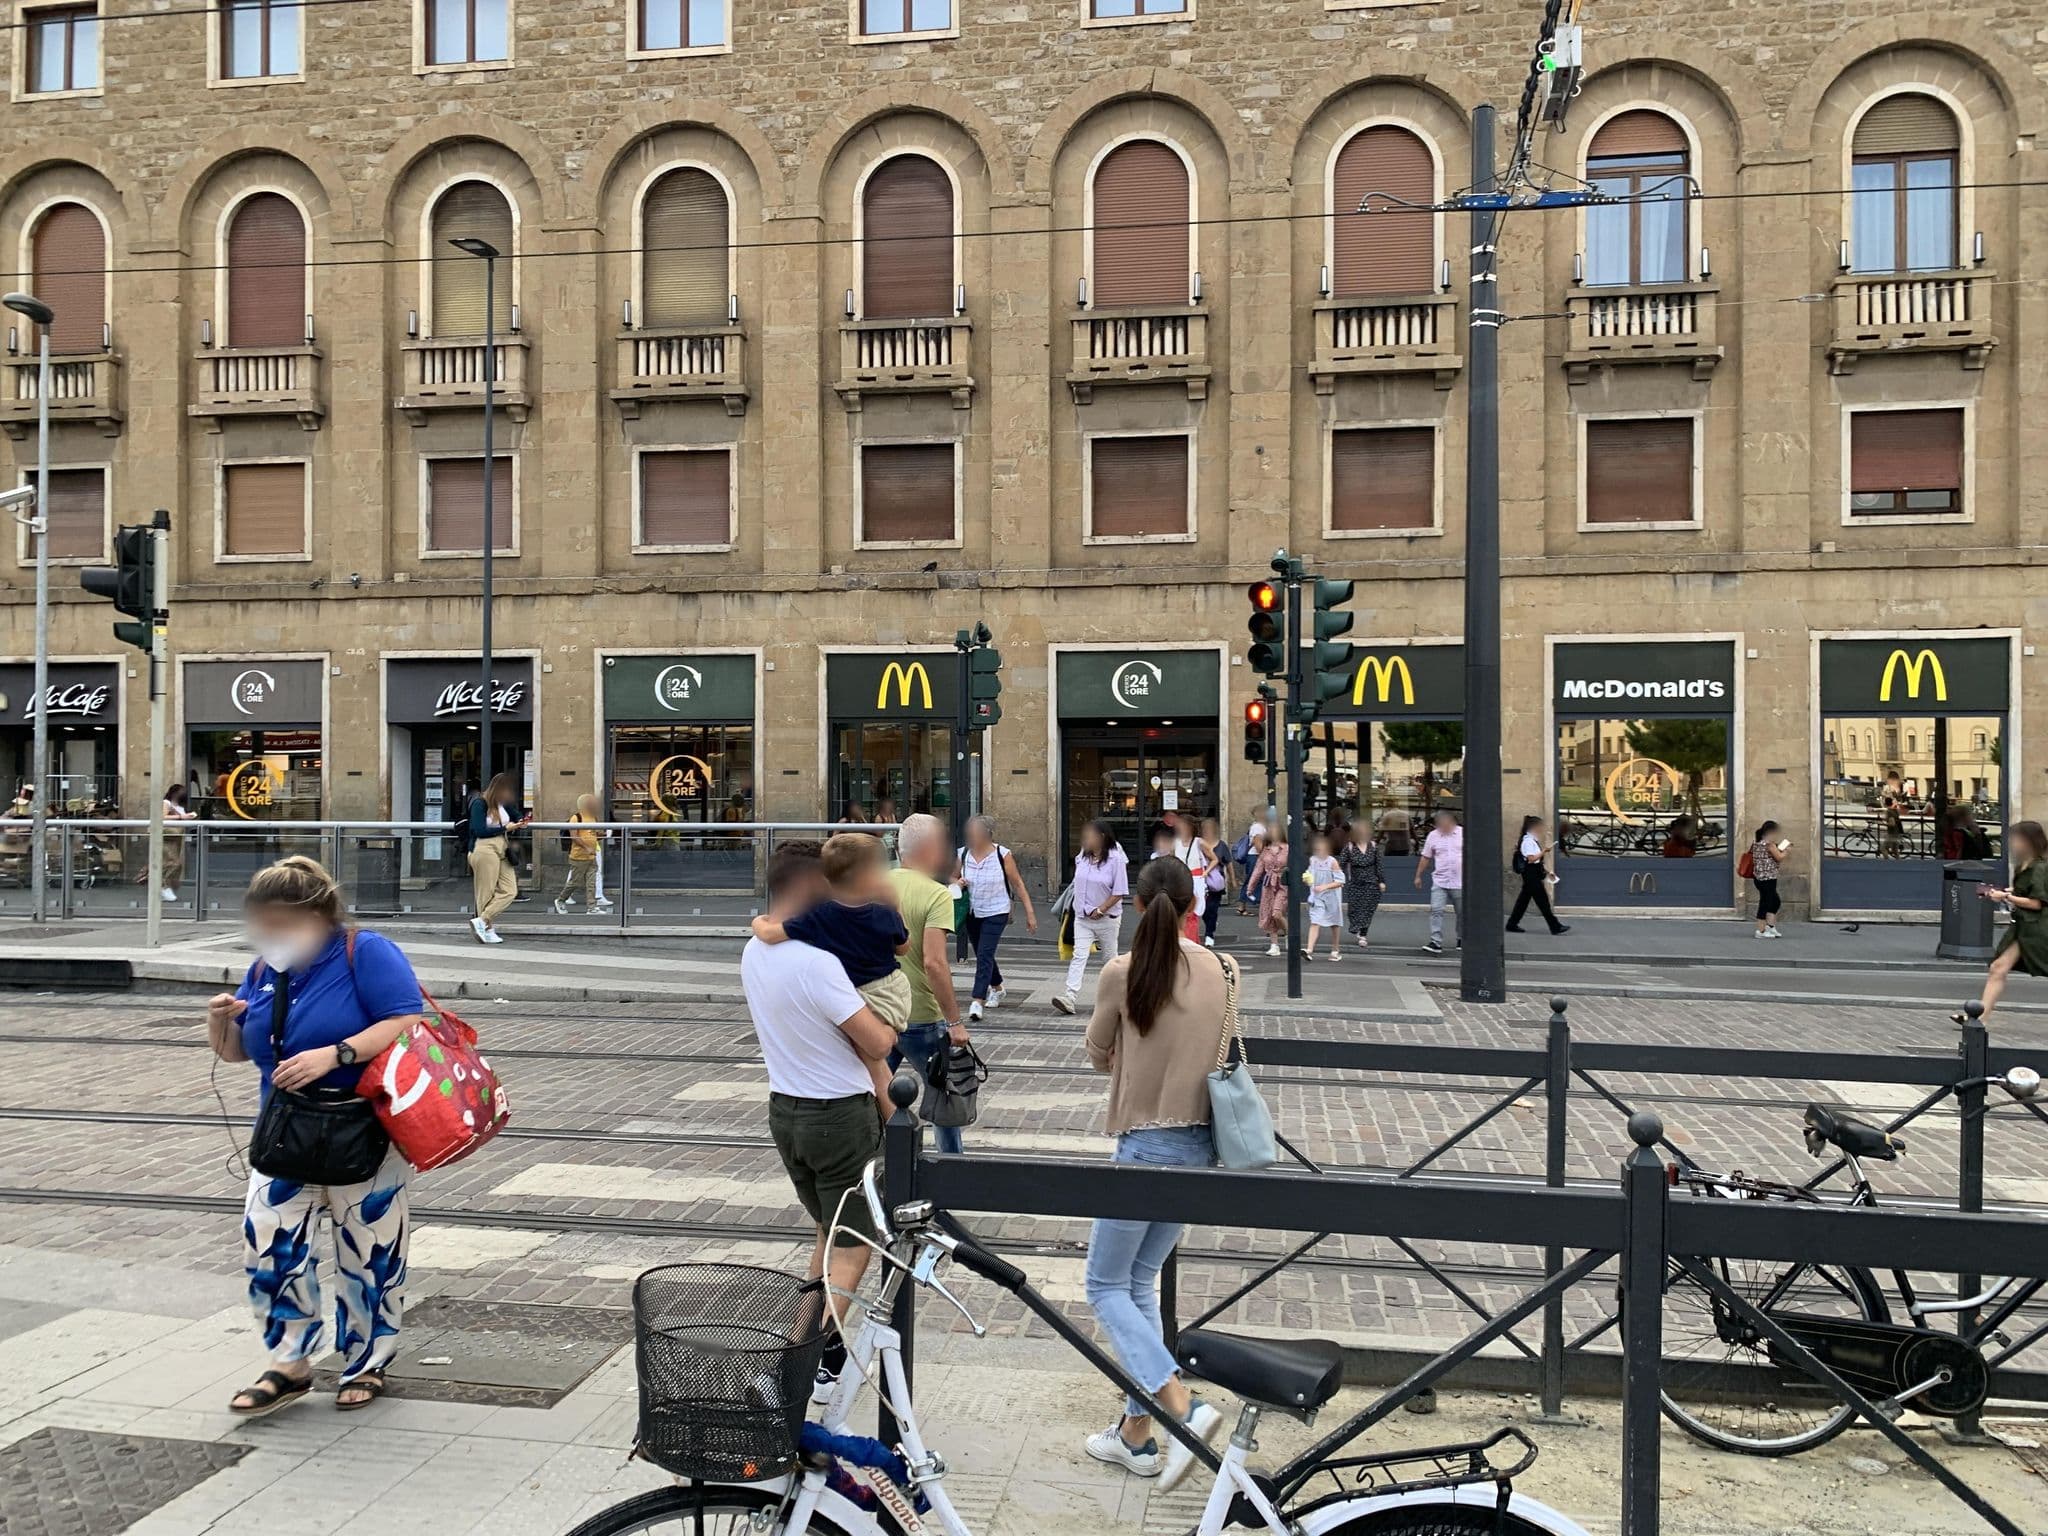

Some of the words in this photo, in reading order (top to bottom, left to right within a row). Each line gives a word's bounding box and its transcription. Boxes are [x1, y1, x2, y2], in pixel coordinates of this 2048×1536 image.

[671, 678, 690, 691] 24
[1129, 674, 1149, 688] 24
[246, 683, 264, 695] 24
[1129, 687, 1149, 696] ORE
[1563, 679, 1725, 698] McDonald's
[247, 695, 264, 703] ORE
[436, 679, 524, 713] McCafé
[672, 769, 696, 786] 24
[1632, 773, 1660, 792] 24
[247, 776, 272, 795] 24
[672, 787, 696, 796] ORE
[247, 795, 273, 805] ORE
[1632, 792, 1660, 803] ORE
[862, 1466, 921, 1533] ulipano
